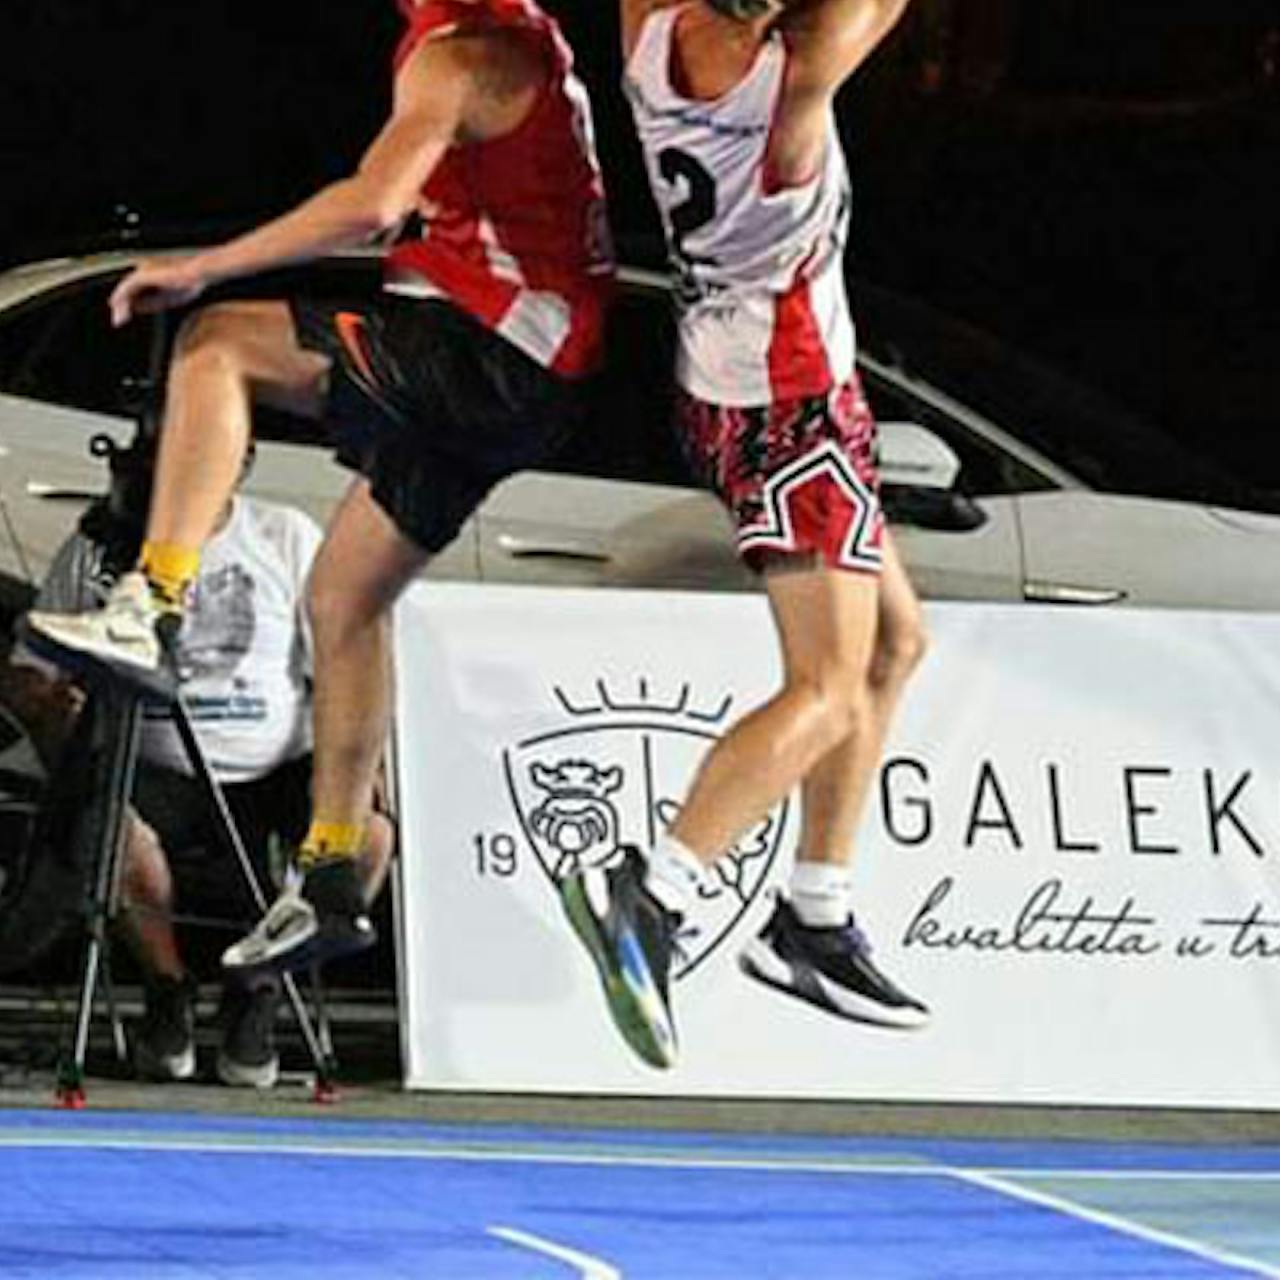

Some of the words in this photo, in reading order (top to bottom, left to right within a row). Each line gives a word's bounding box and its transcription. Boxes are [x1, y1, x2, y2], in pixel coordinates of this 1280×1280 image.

[657, 146, 721, 267] 2
[474, 832, 516, 877] 19
[902, 877, 1160, 954] kvaliteta
[1176, 934, 1215, 958] u
